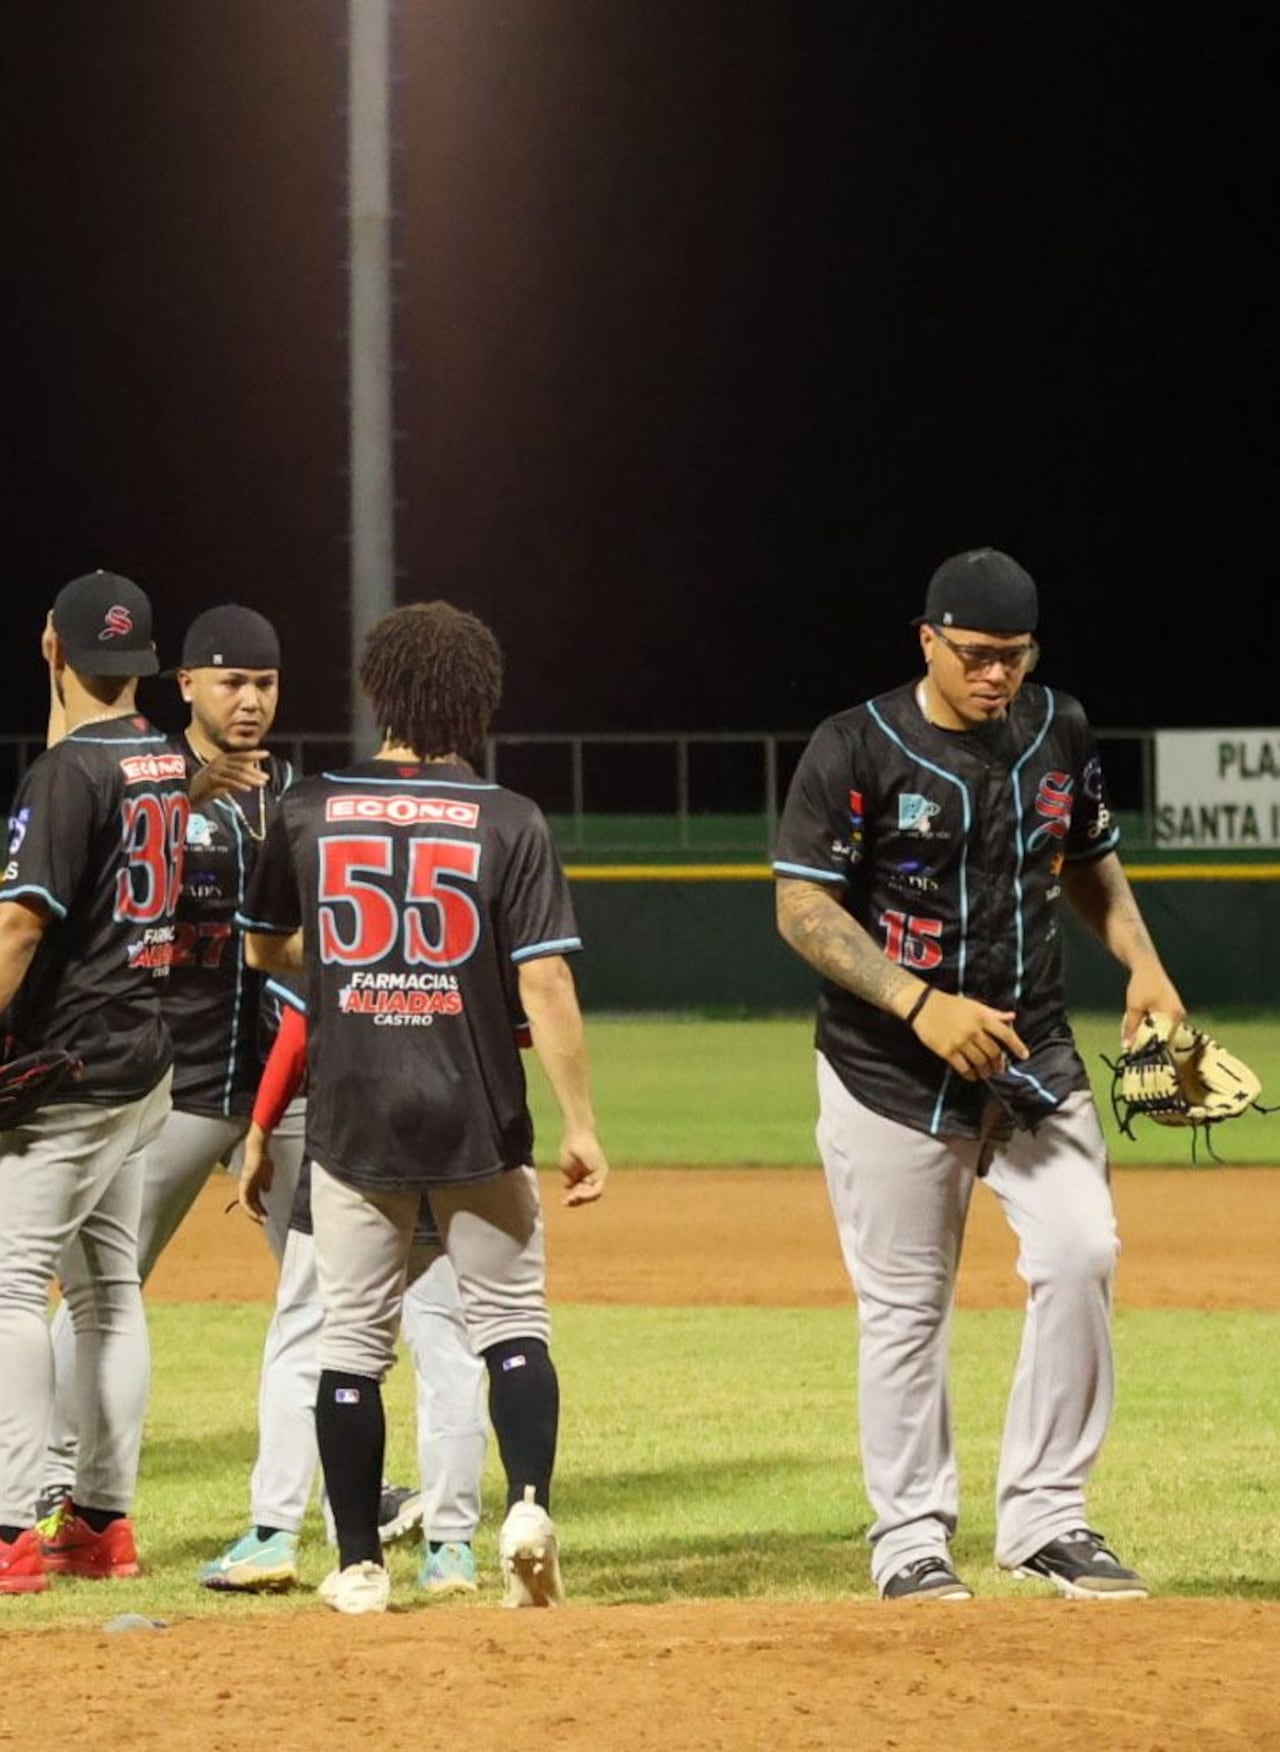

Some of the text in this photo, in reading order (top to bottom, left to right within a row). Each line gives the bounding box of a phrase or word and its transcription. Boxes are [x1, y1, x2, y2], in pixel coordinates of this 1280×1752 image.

[98, 604, 133, 640] S
[1218, 741, 1280, 780] PLA
[331, 799, 476, 823] ECONO
[1027, 770, 1073, 851] S
[1153, 804, 1260, 841] SANTA
[317, 834, 481, 967] 55
[173, 923, 232, 968] 27
[879, 909, 944, 970] 15
[350, 971, 459, 991] FARMACIAS
[340, 989, 463, 1015] ALIADAS
[373, 1013, 433, 1026] CASTRO
